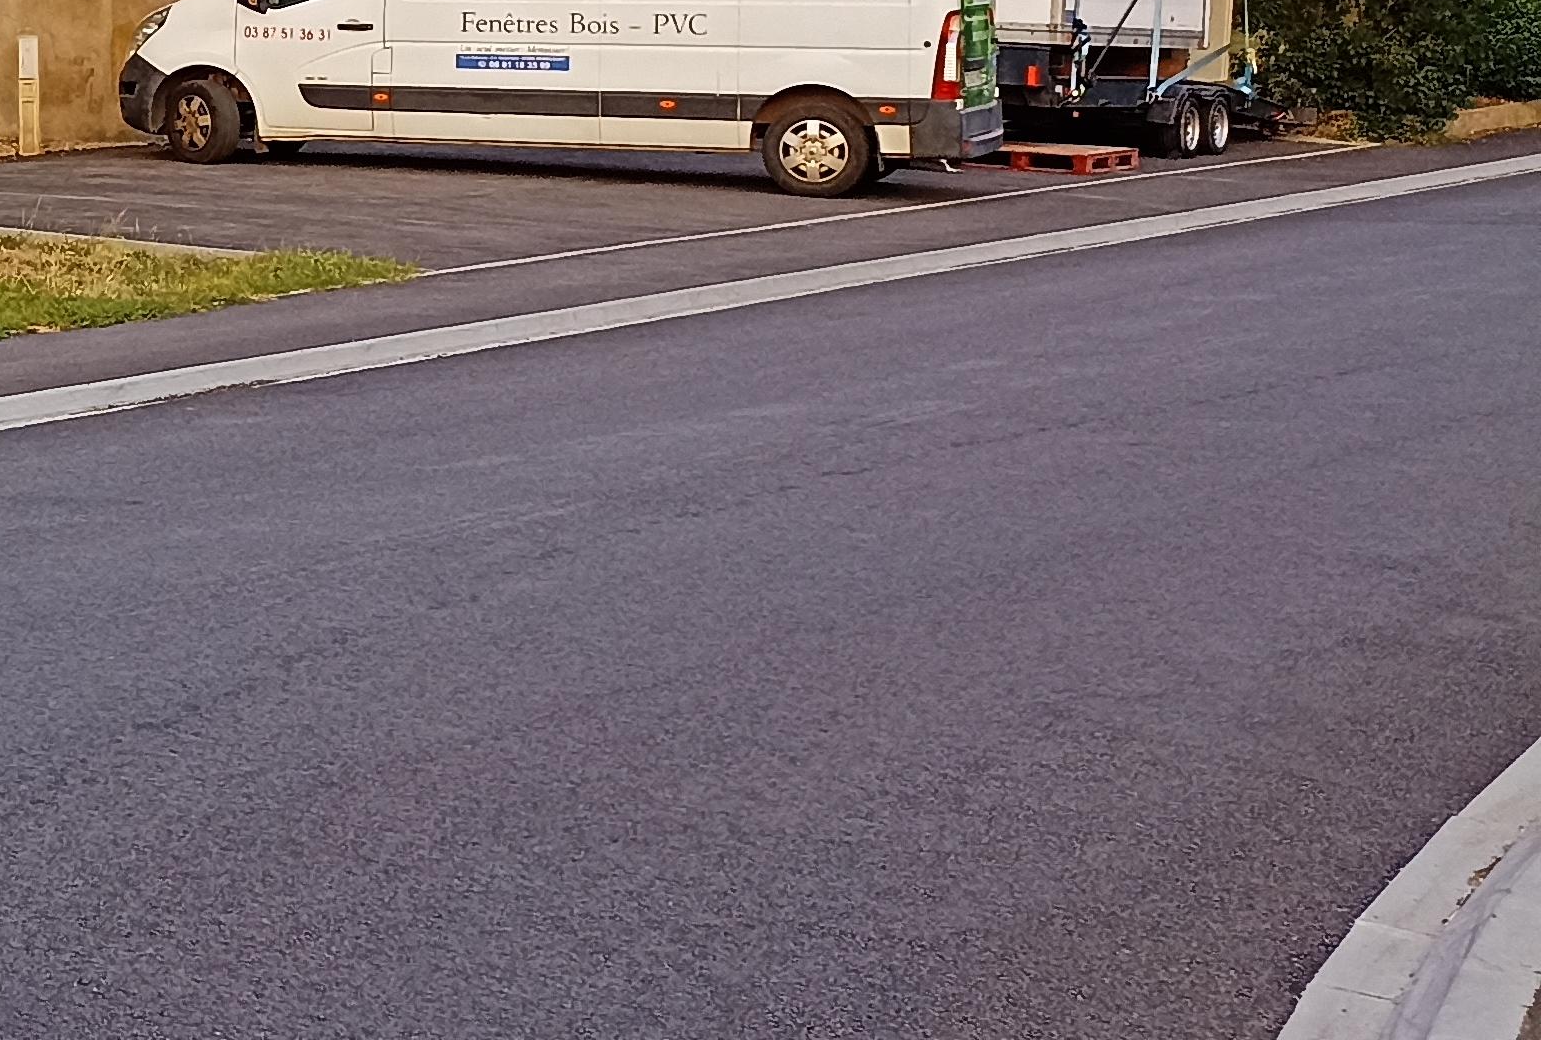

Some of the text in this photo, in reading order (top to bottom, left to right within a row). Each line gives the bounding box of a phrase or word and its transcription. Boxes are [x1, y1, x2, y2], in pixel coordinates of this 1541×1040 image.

[244, 25, 331, 41] 03 87 51 36 31
[460, 11, 559, 34] Fenêtres
[569, 12, 620, 35] Bois
[652, 12, 708, 36] PVC
